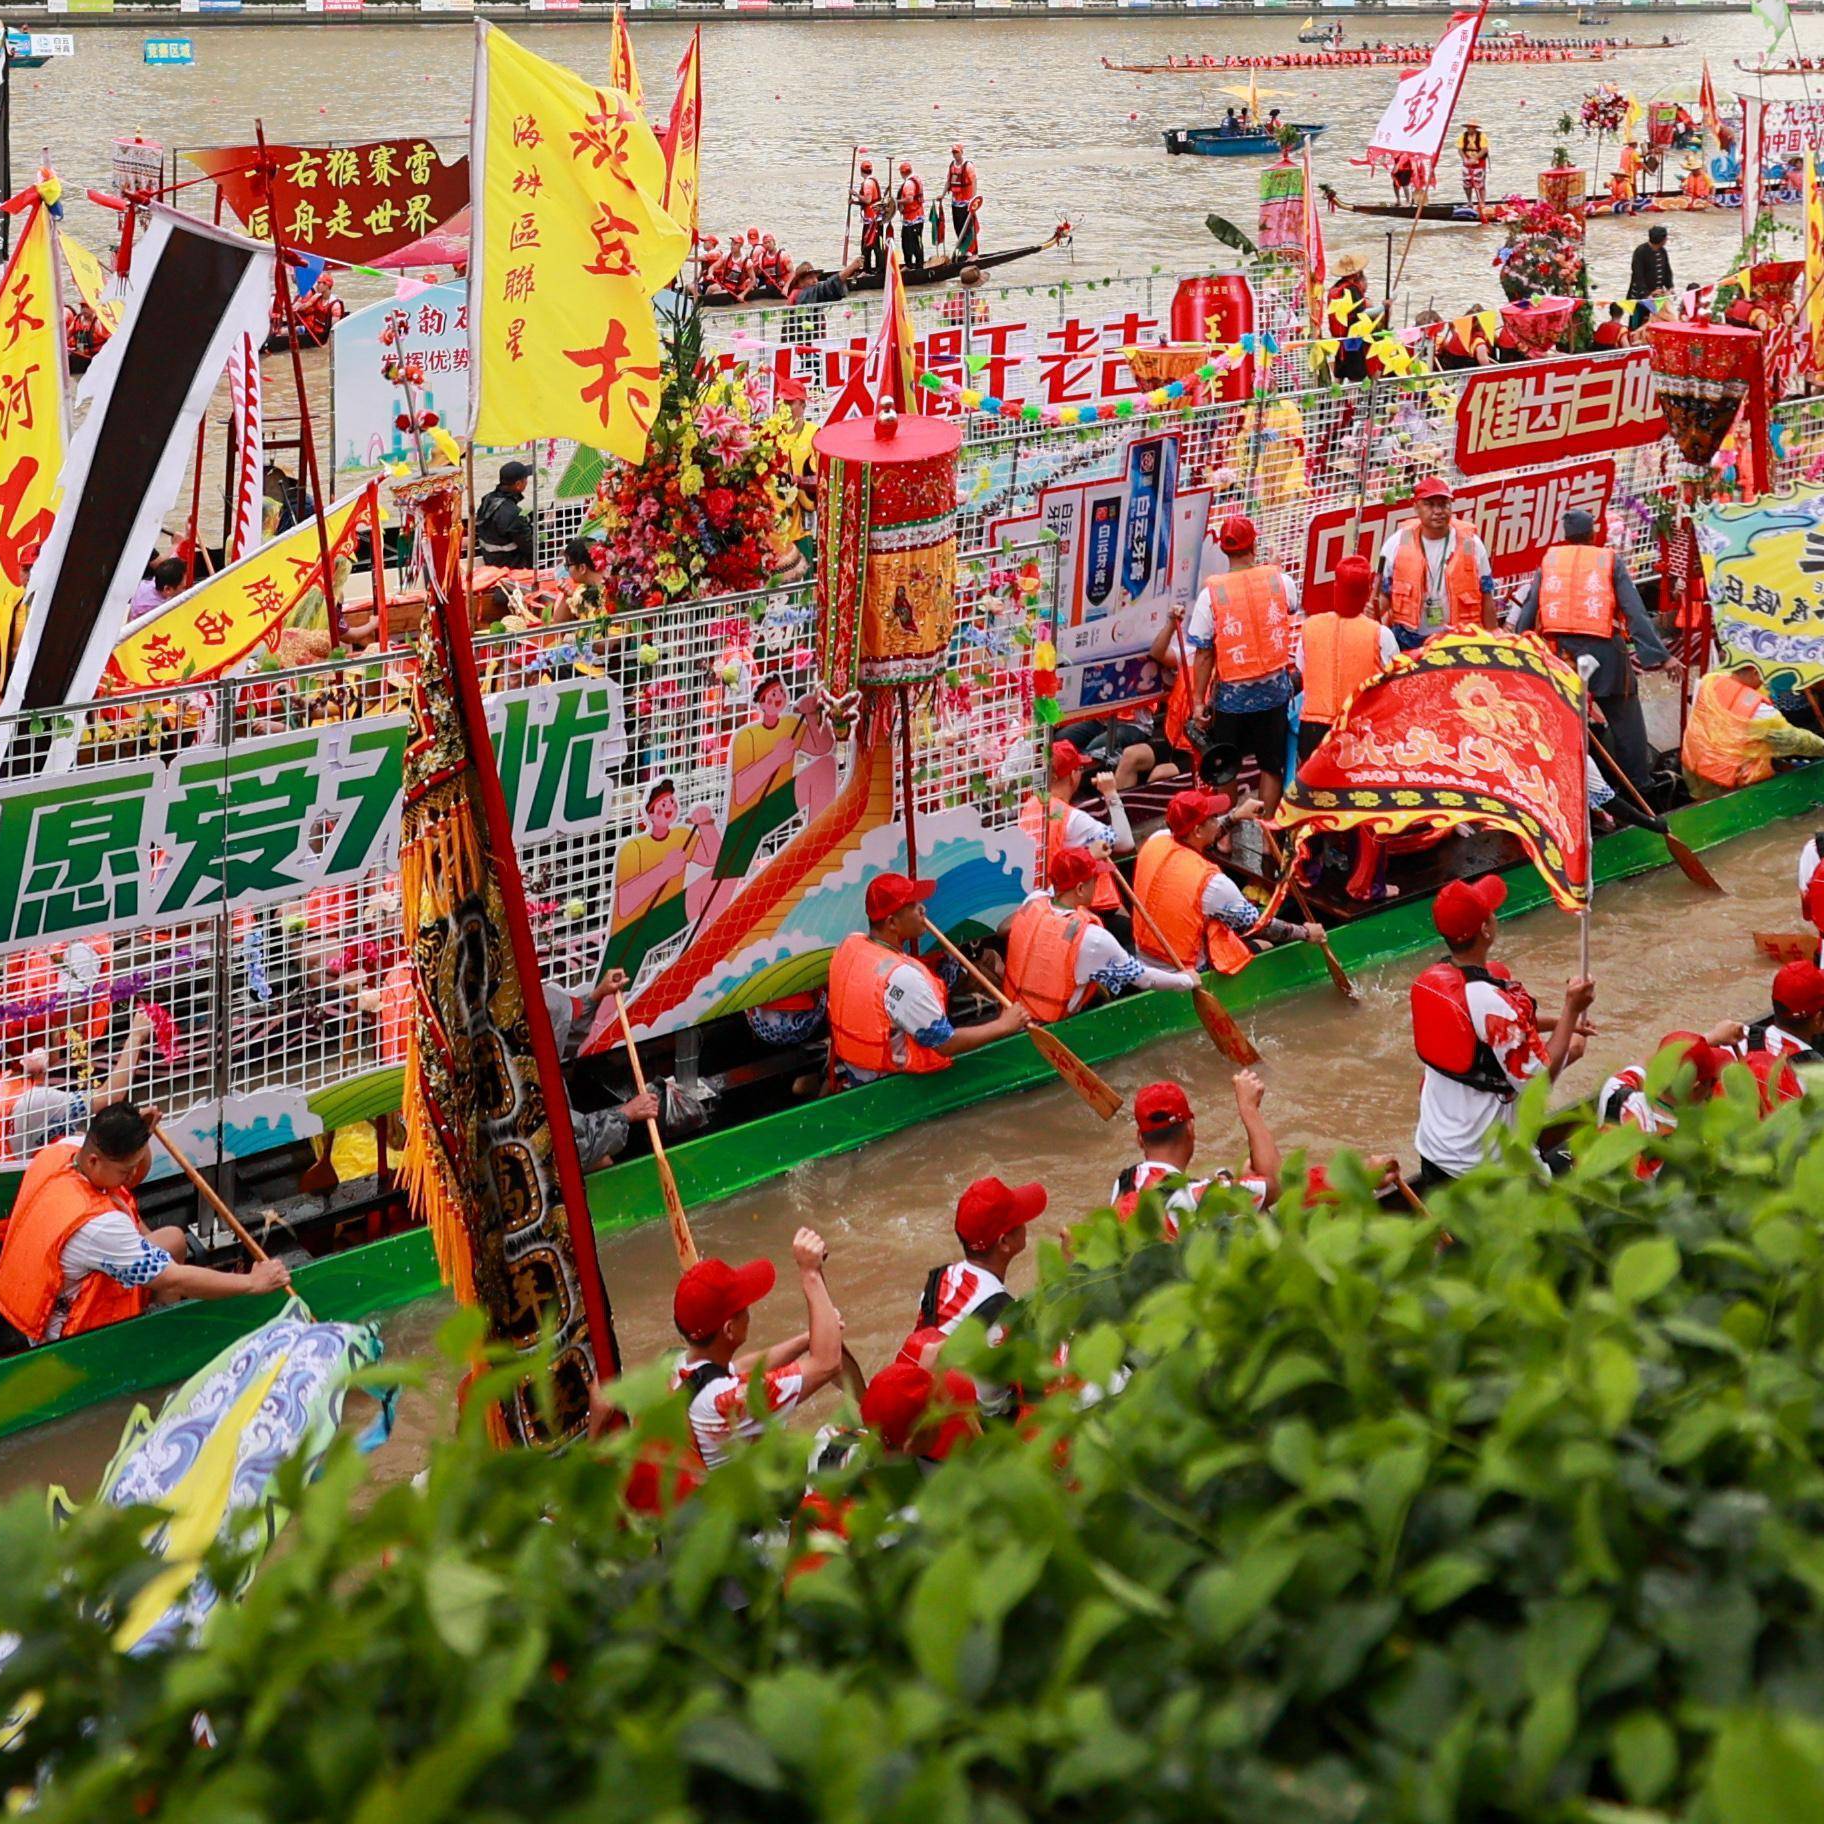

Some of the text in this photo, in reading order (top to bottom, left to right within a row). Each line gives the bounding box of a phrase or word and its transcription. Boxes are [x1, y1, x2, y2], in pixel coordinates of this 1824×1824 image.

[244, 143, 437, 189] 右猴赛雷
[1313, 469, 1607, 587] 中新制造
